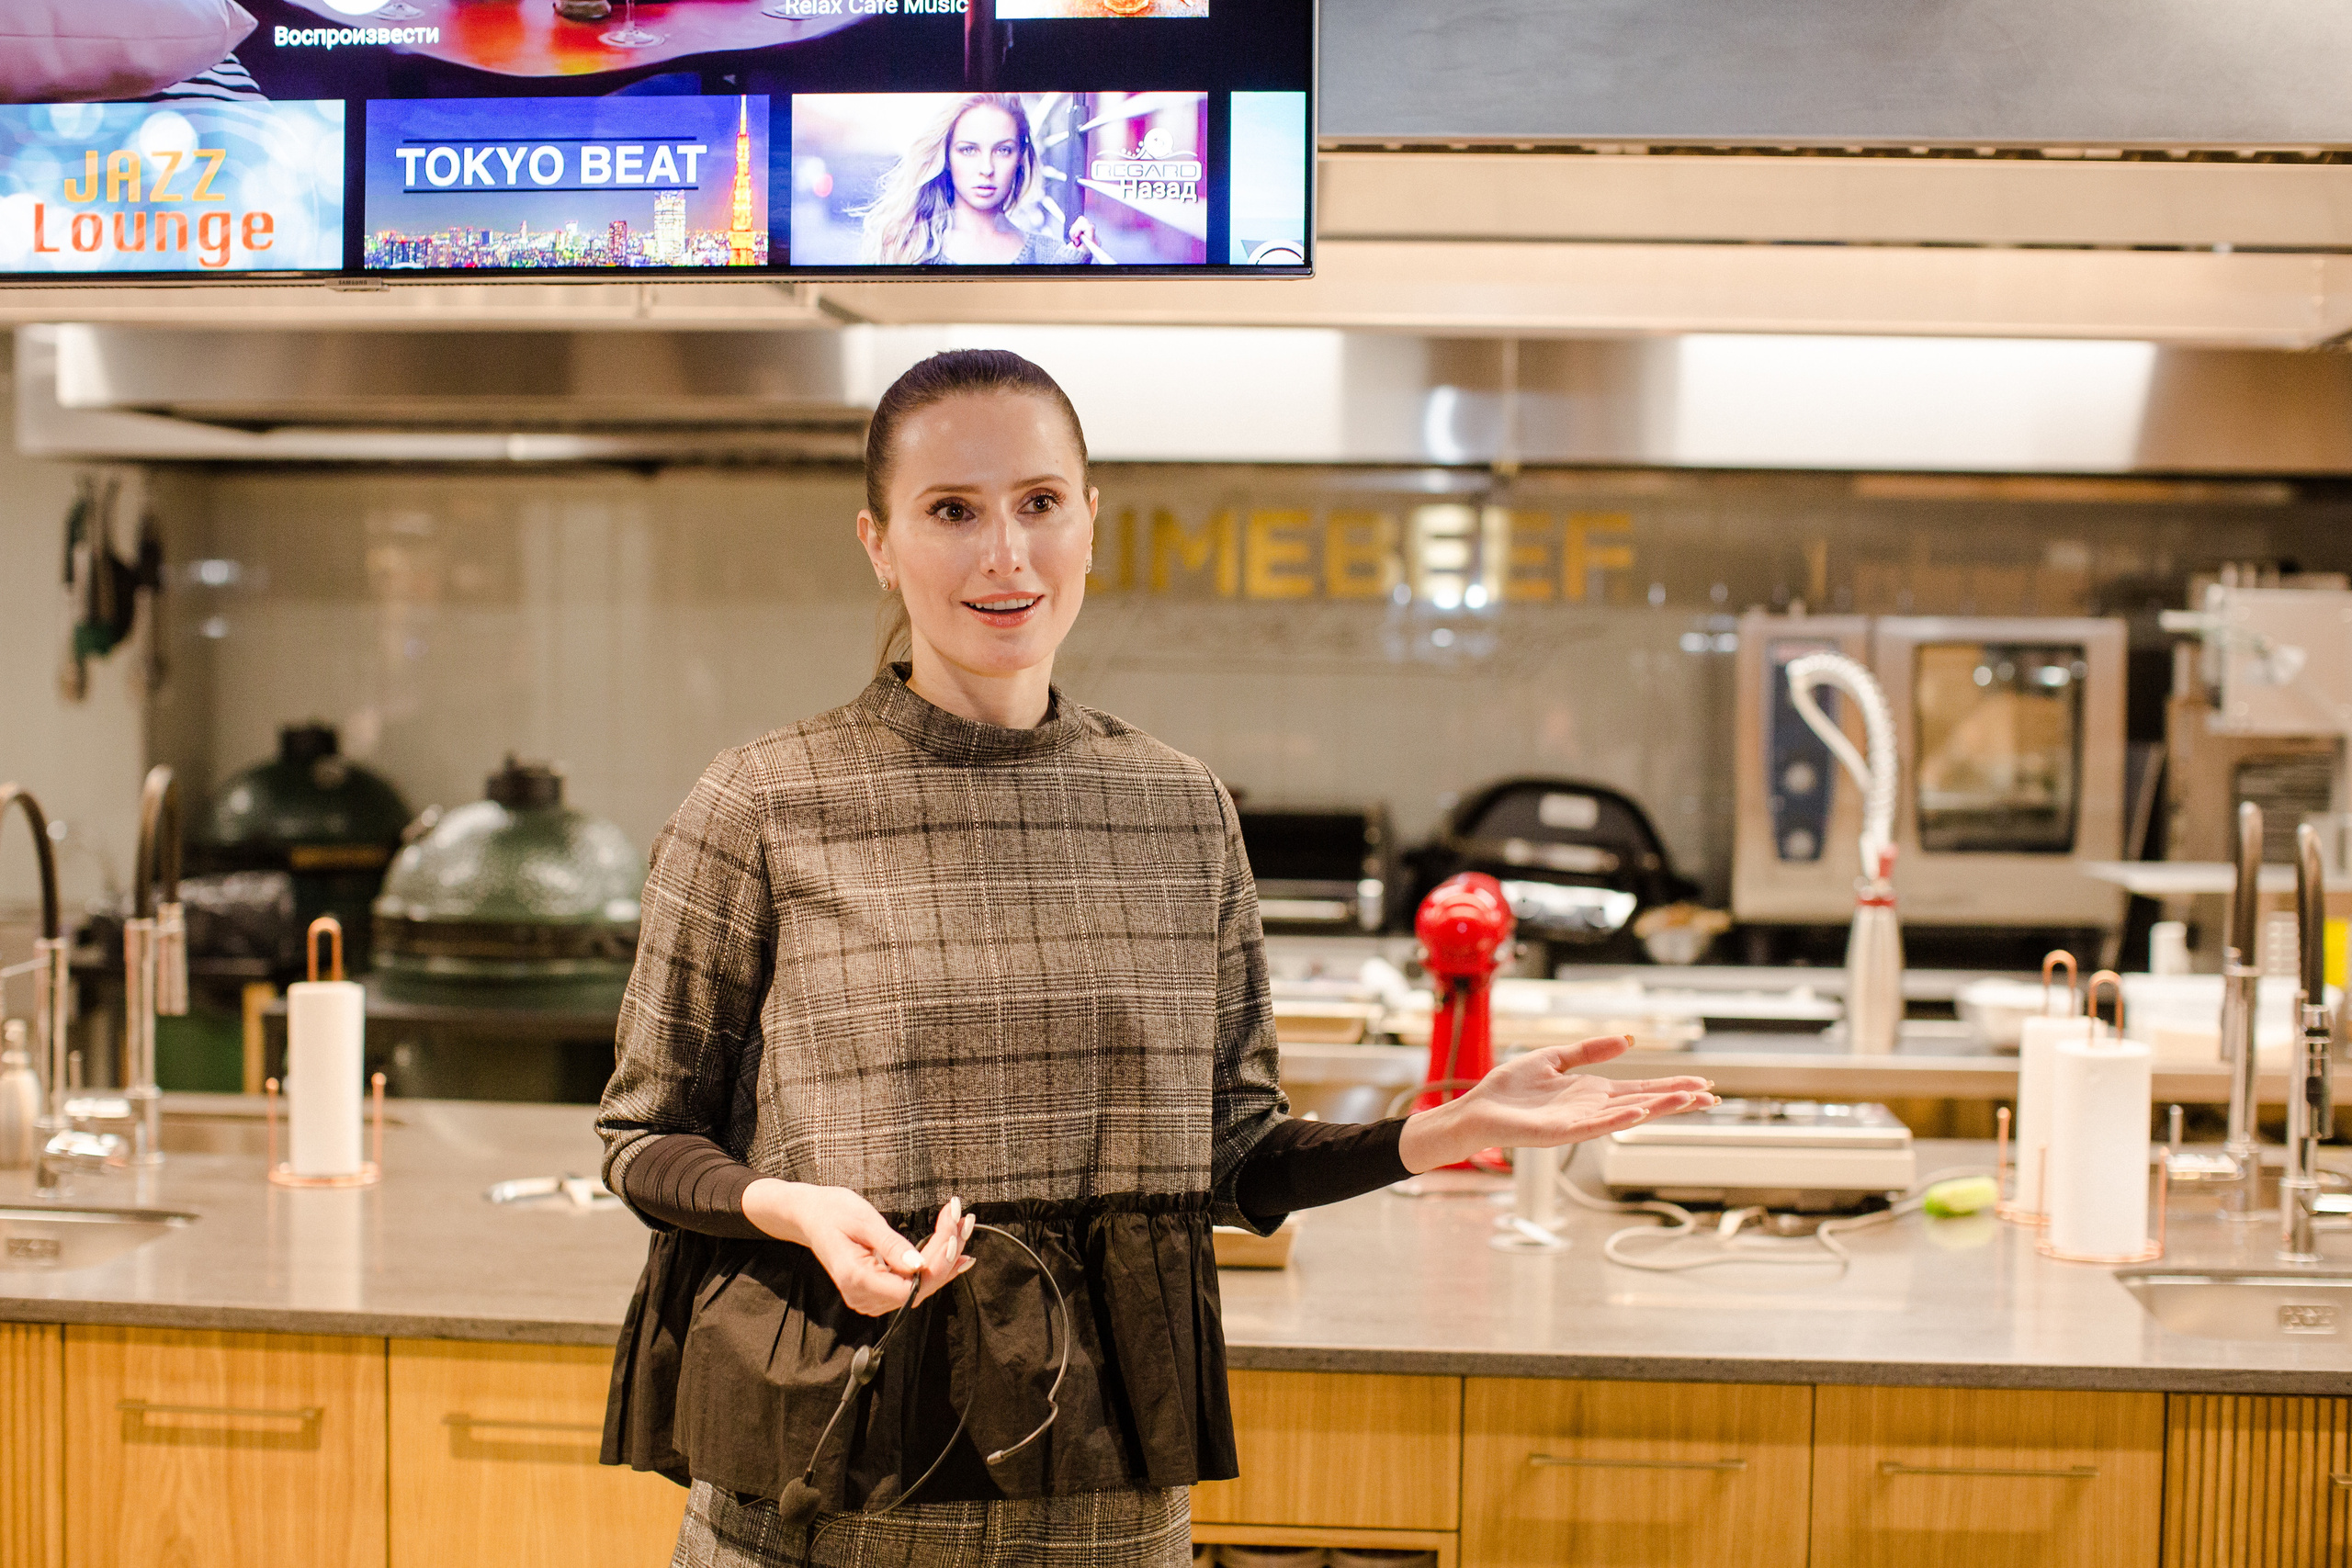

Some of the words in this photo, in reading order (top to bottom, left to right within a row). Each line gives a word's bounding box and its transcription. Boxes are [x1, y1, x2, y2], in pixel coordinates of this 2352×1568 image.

[786, 0, 842, 15] Relax
[903, 0, 969, 14] Music
[274, 25, 440, 50] Воспроизвести
[63, 148, 227, 203] JAZZ
[395, 145, 565, 187] TOKYO
[580, 144, 708, 186] BEAT
[1095, 164, 1198, 178] REGARD
[1120, 178, 1198, 203] Назад
[33, 203, 275, 267] Lounge
[1085, 508, 1636, 599] IMEBEEF
